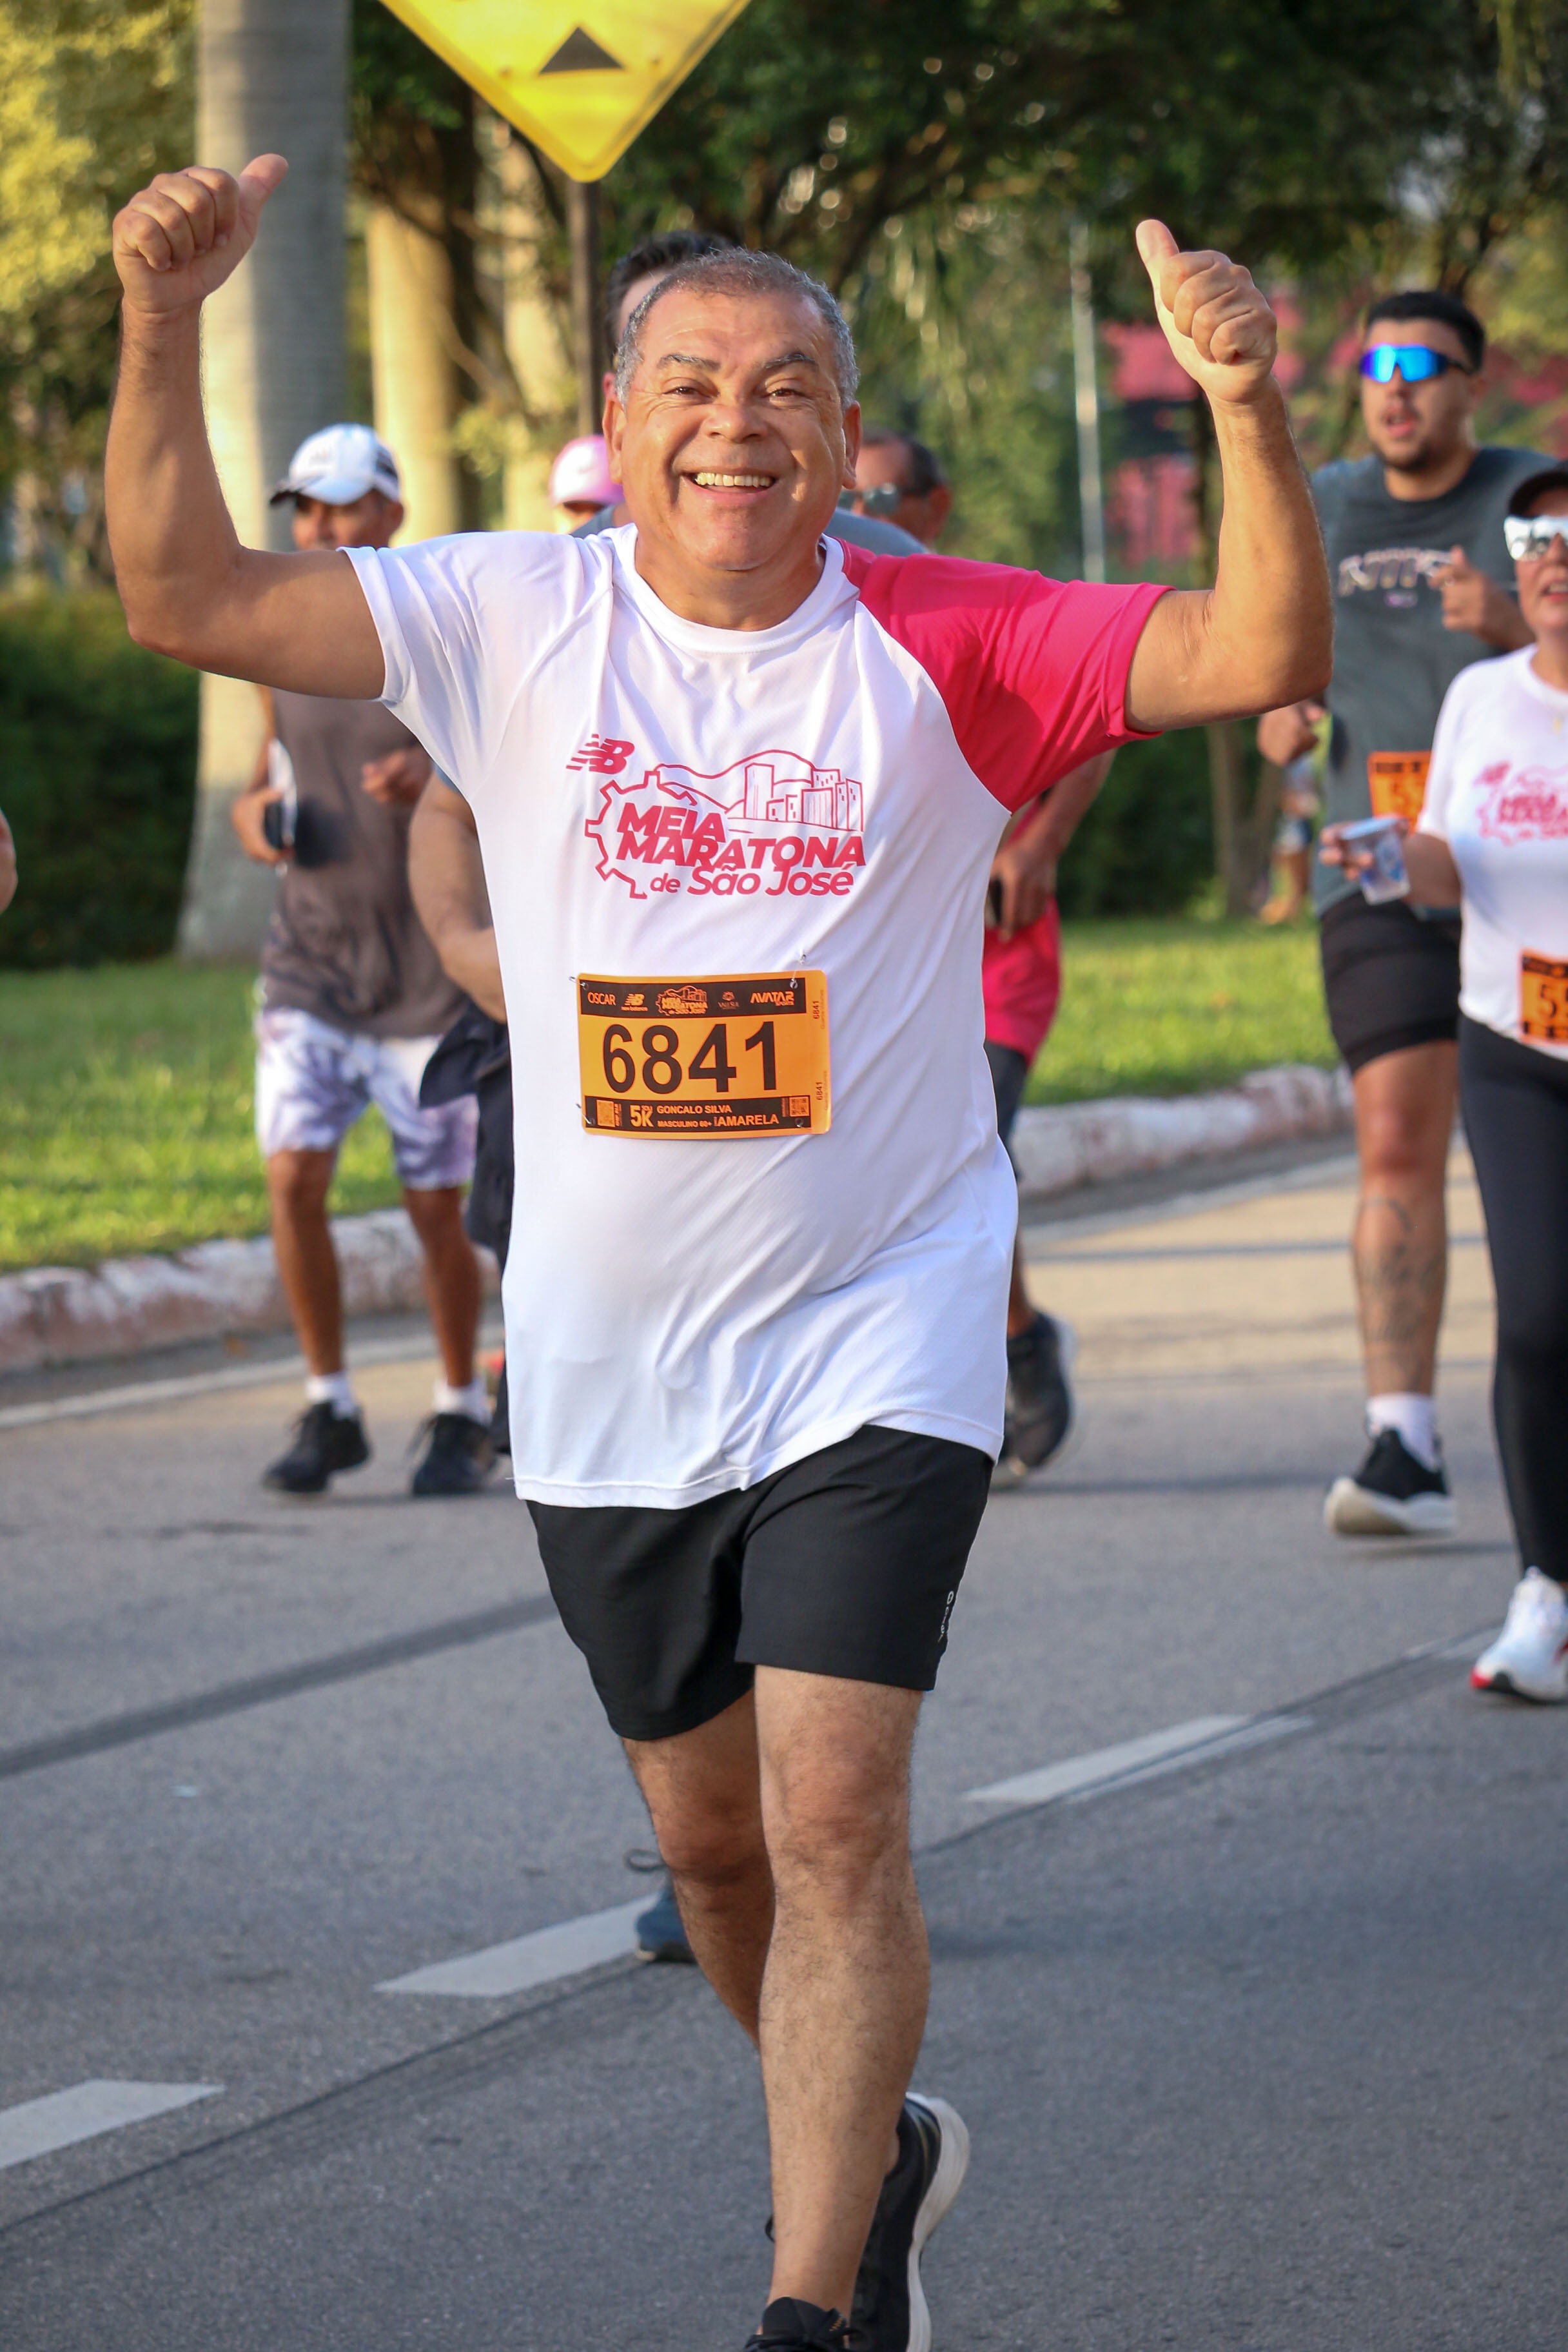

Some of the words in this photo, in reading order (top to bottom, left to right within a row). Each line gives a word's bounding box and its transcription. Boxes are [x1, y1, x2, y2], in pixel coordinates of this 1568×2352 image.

[617, 803, 727, 843] MEIA
[616, 830, 866, 870] MARATONA
[649, 873, 681, 894] de
[687, 865, 761, 896] São
[765, 863, 854, 896] José
[587, 992, 616, 1006] OSCAR
[750, 990, 794, 1004] AVATAR
[1540, 983, 1568, 1019] 5
[603, 1021, 777, 1094] 6841
[630, 1104, 654, 1127] 5K
[656, 1105, 703, 1114] GONCALO
[704, 1104, 732, 1114] SILVA
